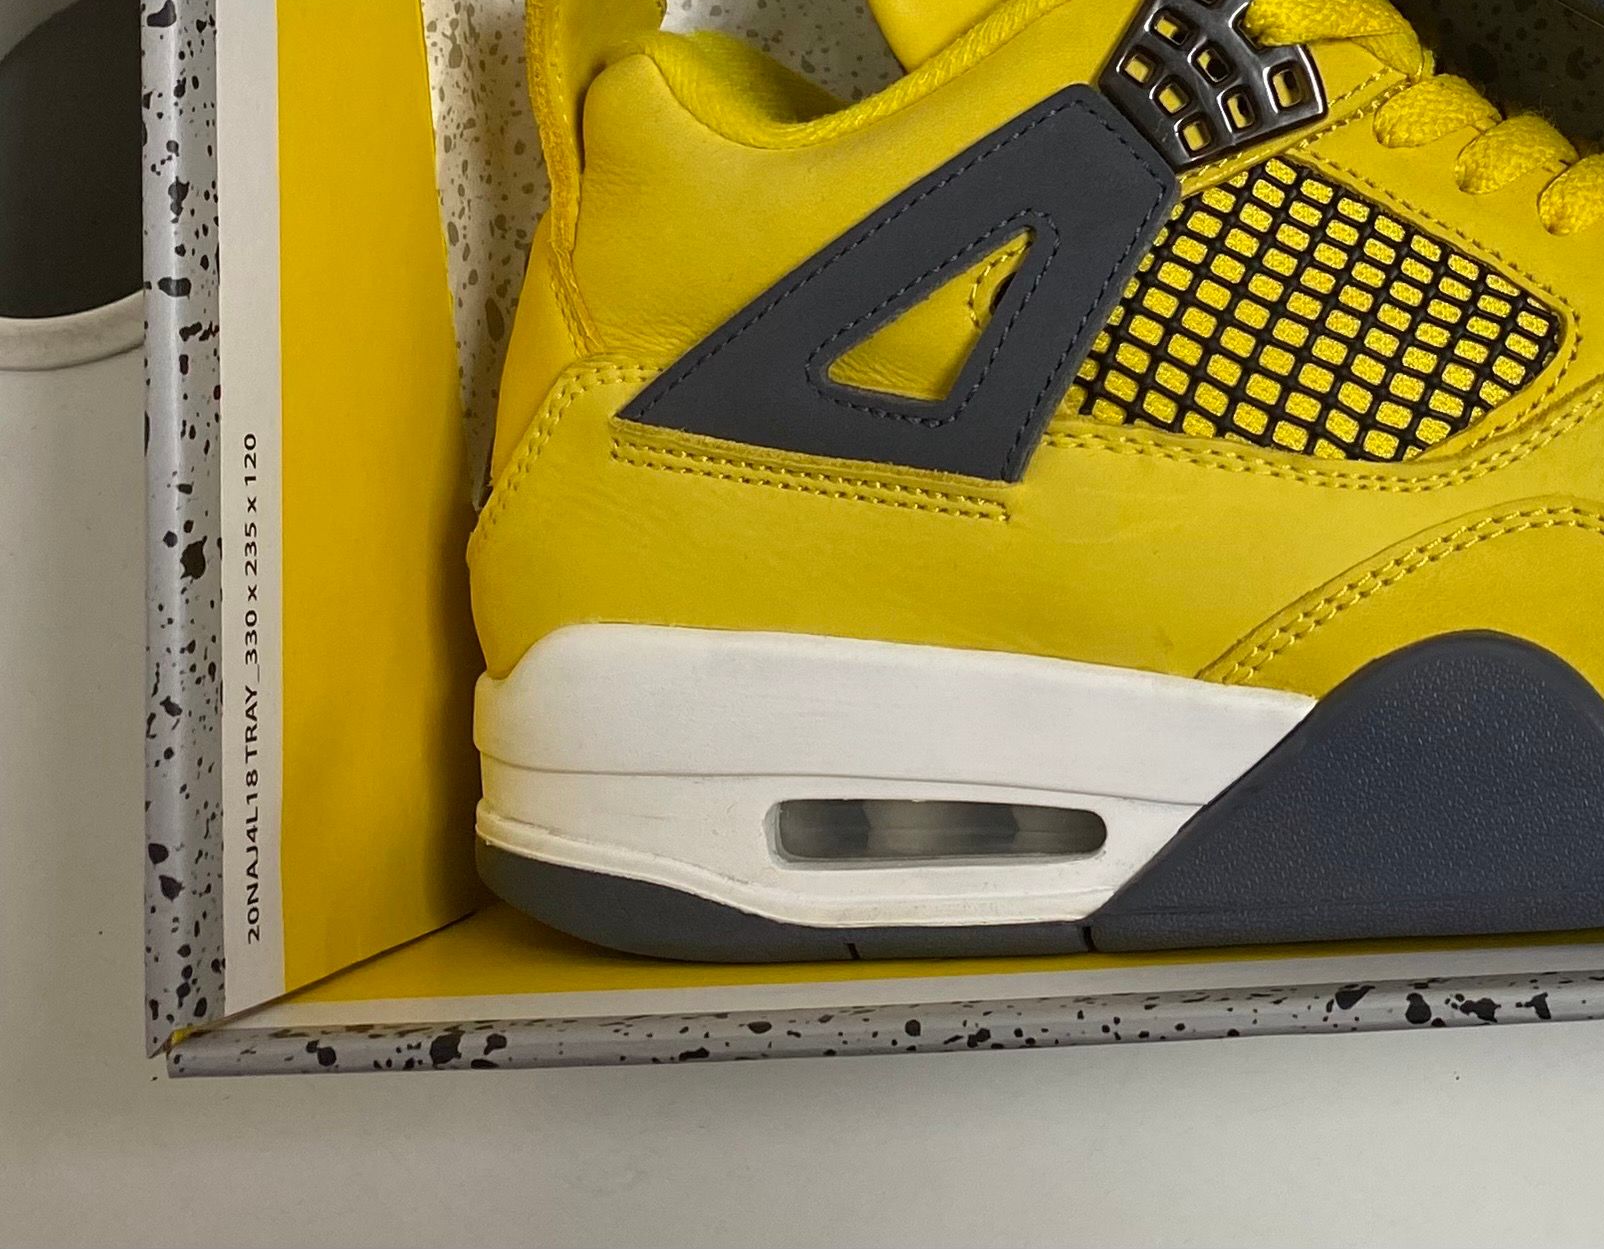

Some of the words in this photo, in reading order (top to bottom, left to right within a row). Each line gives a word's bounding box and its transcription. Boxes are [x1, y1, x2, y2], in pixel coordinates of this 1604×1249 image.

[243, 433, 257, 487] 120
[247, 496, 257, 514] x
[244, 522, 258, 577] 235
[247, 584, 258, 602] x
